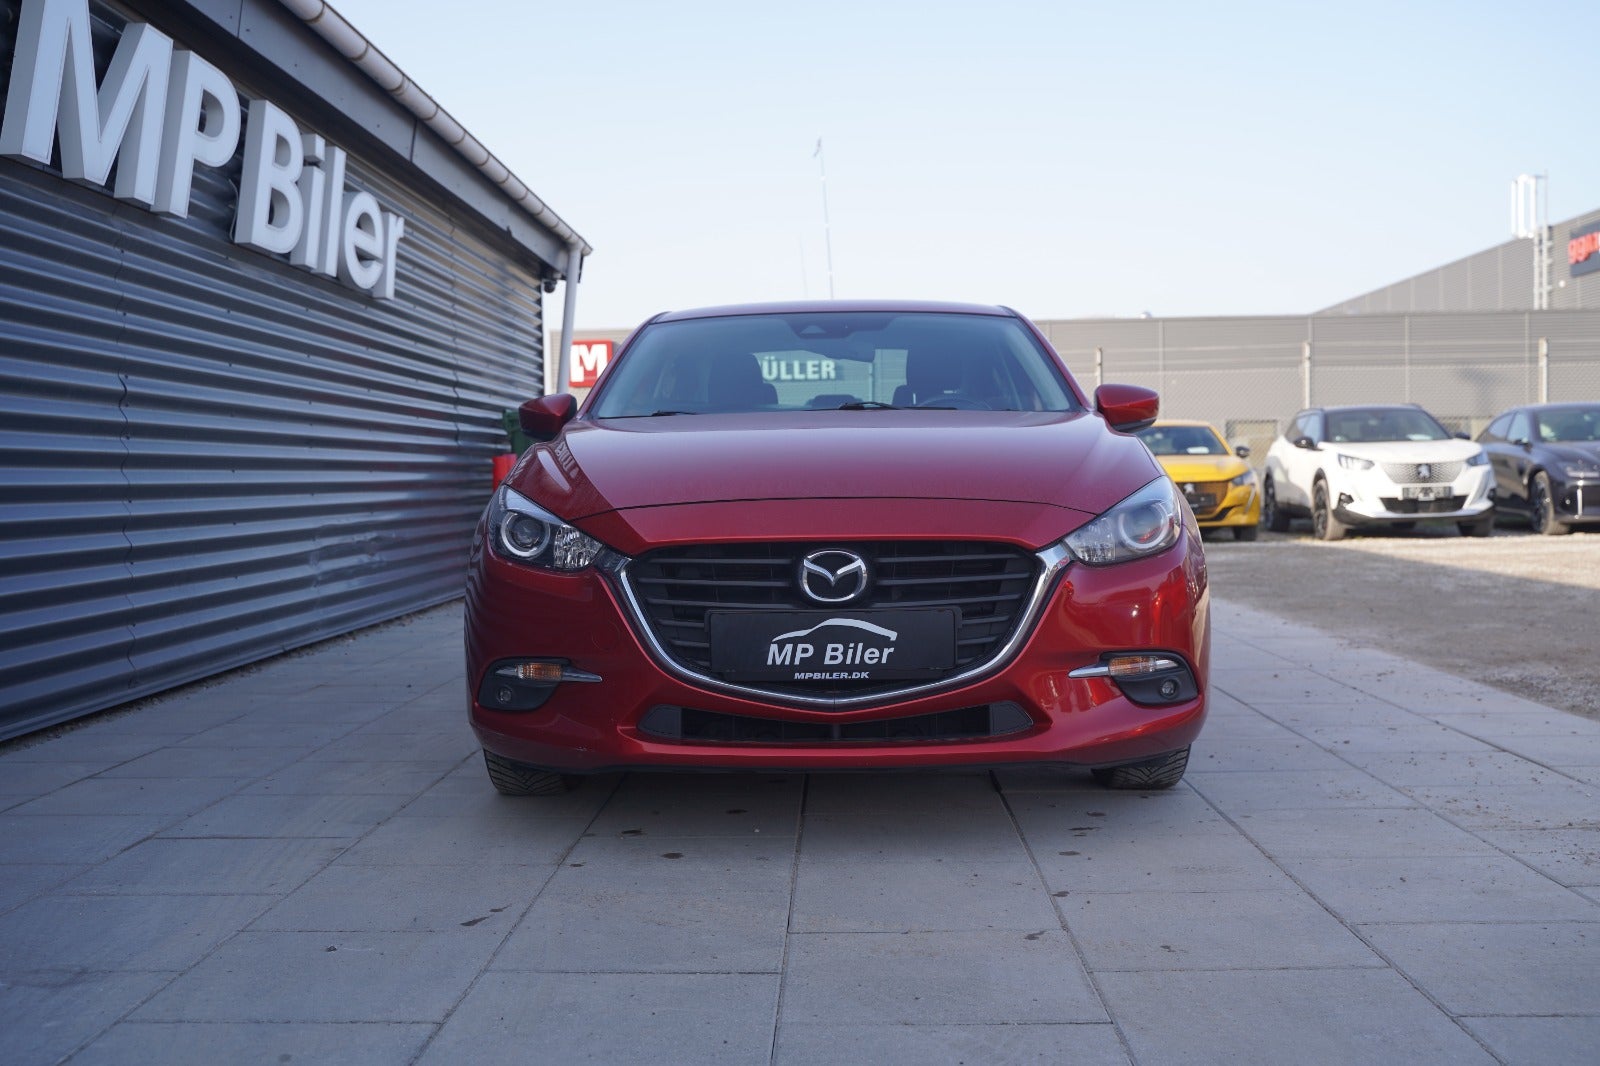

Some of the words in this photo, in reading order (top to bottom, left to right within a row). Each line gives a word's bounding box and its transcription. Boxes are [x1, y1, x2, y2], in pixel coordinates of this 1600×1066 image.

[0, 0, 241, 218] MP
[234, 99, 404, 300] Biler
[570, 343, 608, 383] M
[758, 356, 836, 381] ÜLLER
[766, 643, 814, 666] MP
[823, 642, 895, 665] Biler
[794, 671, 870, 680] MPBILER.DK
